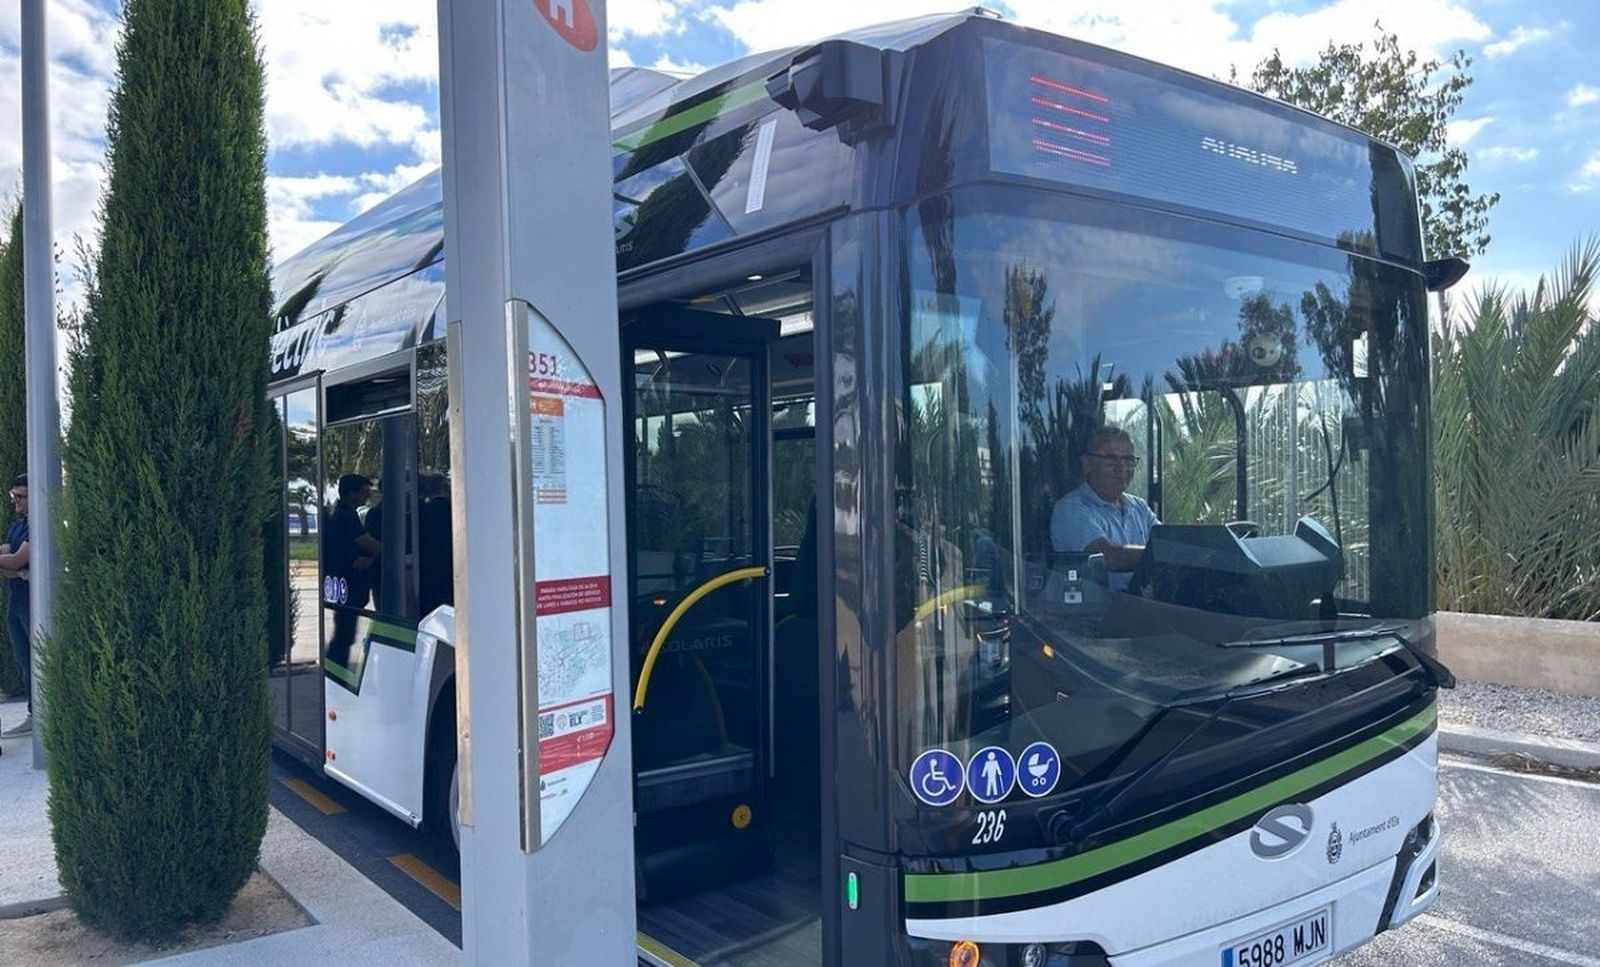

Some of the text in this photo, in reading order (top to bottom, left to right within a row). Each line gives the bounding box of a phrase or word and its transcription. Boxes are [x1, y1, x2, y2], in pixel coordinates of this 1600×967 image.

[528, 352, 560, 377] 351
[663, 634, 734, 652] OLARIS
[569, 715, 583, 728] ELX
[971, 809, 1007, 845] 236
[1349, 823, 1386, 845] Ajuntament
[1238, 917, 1325, 967] 5988 MJN
